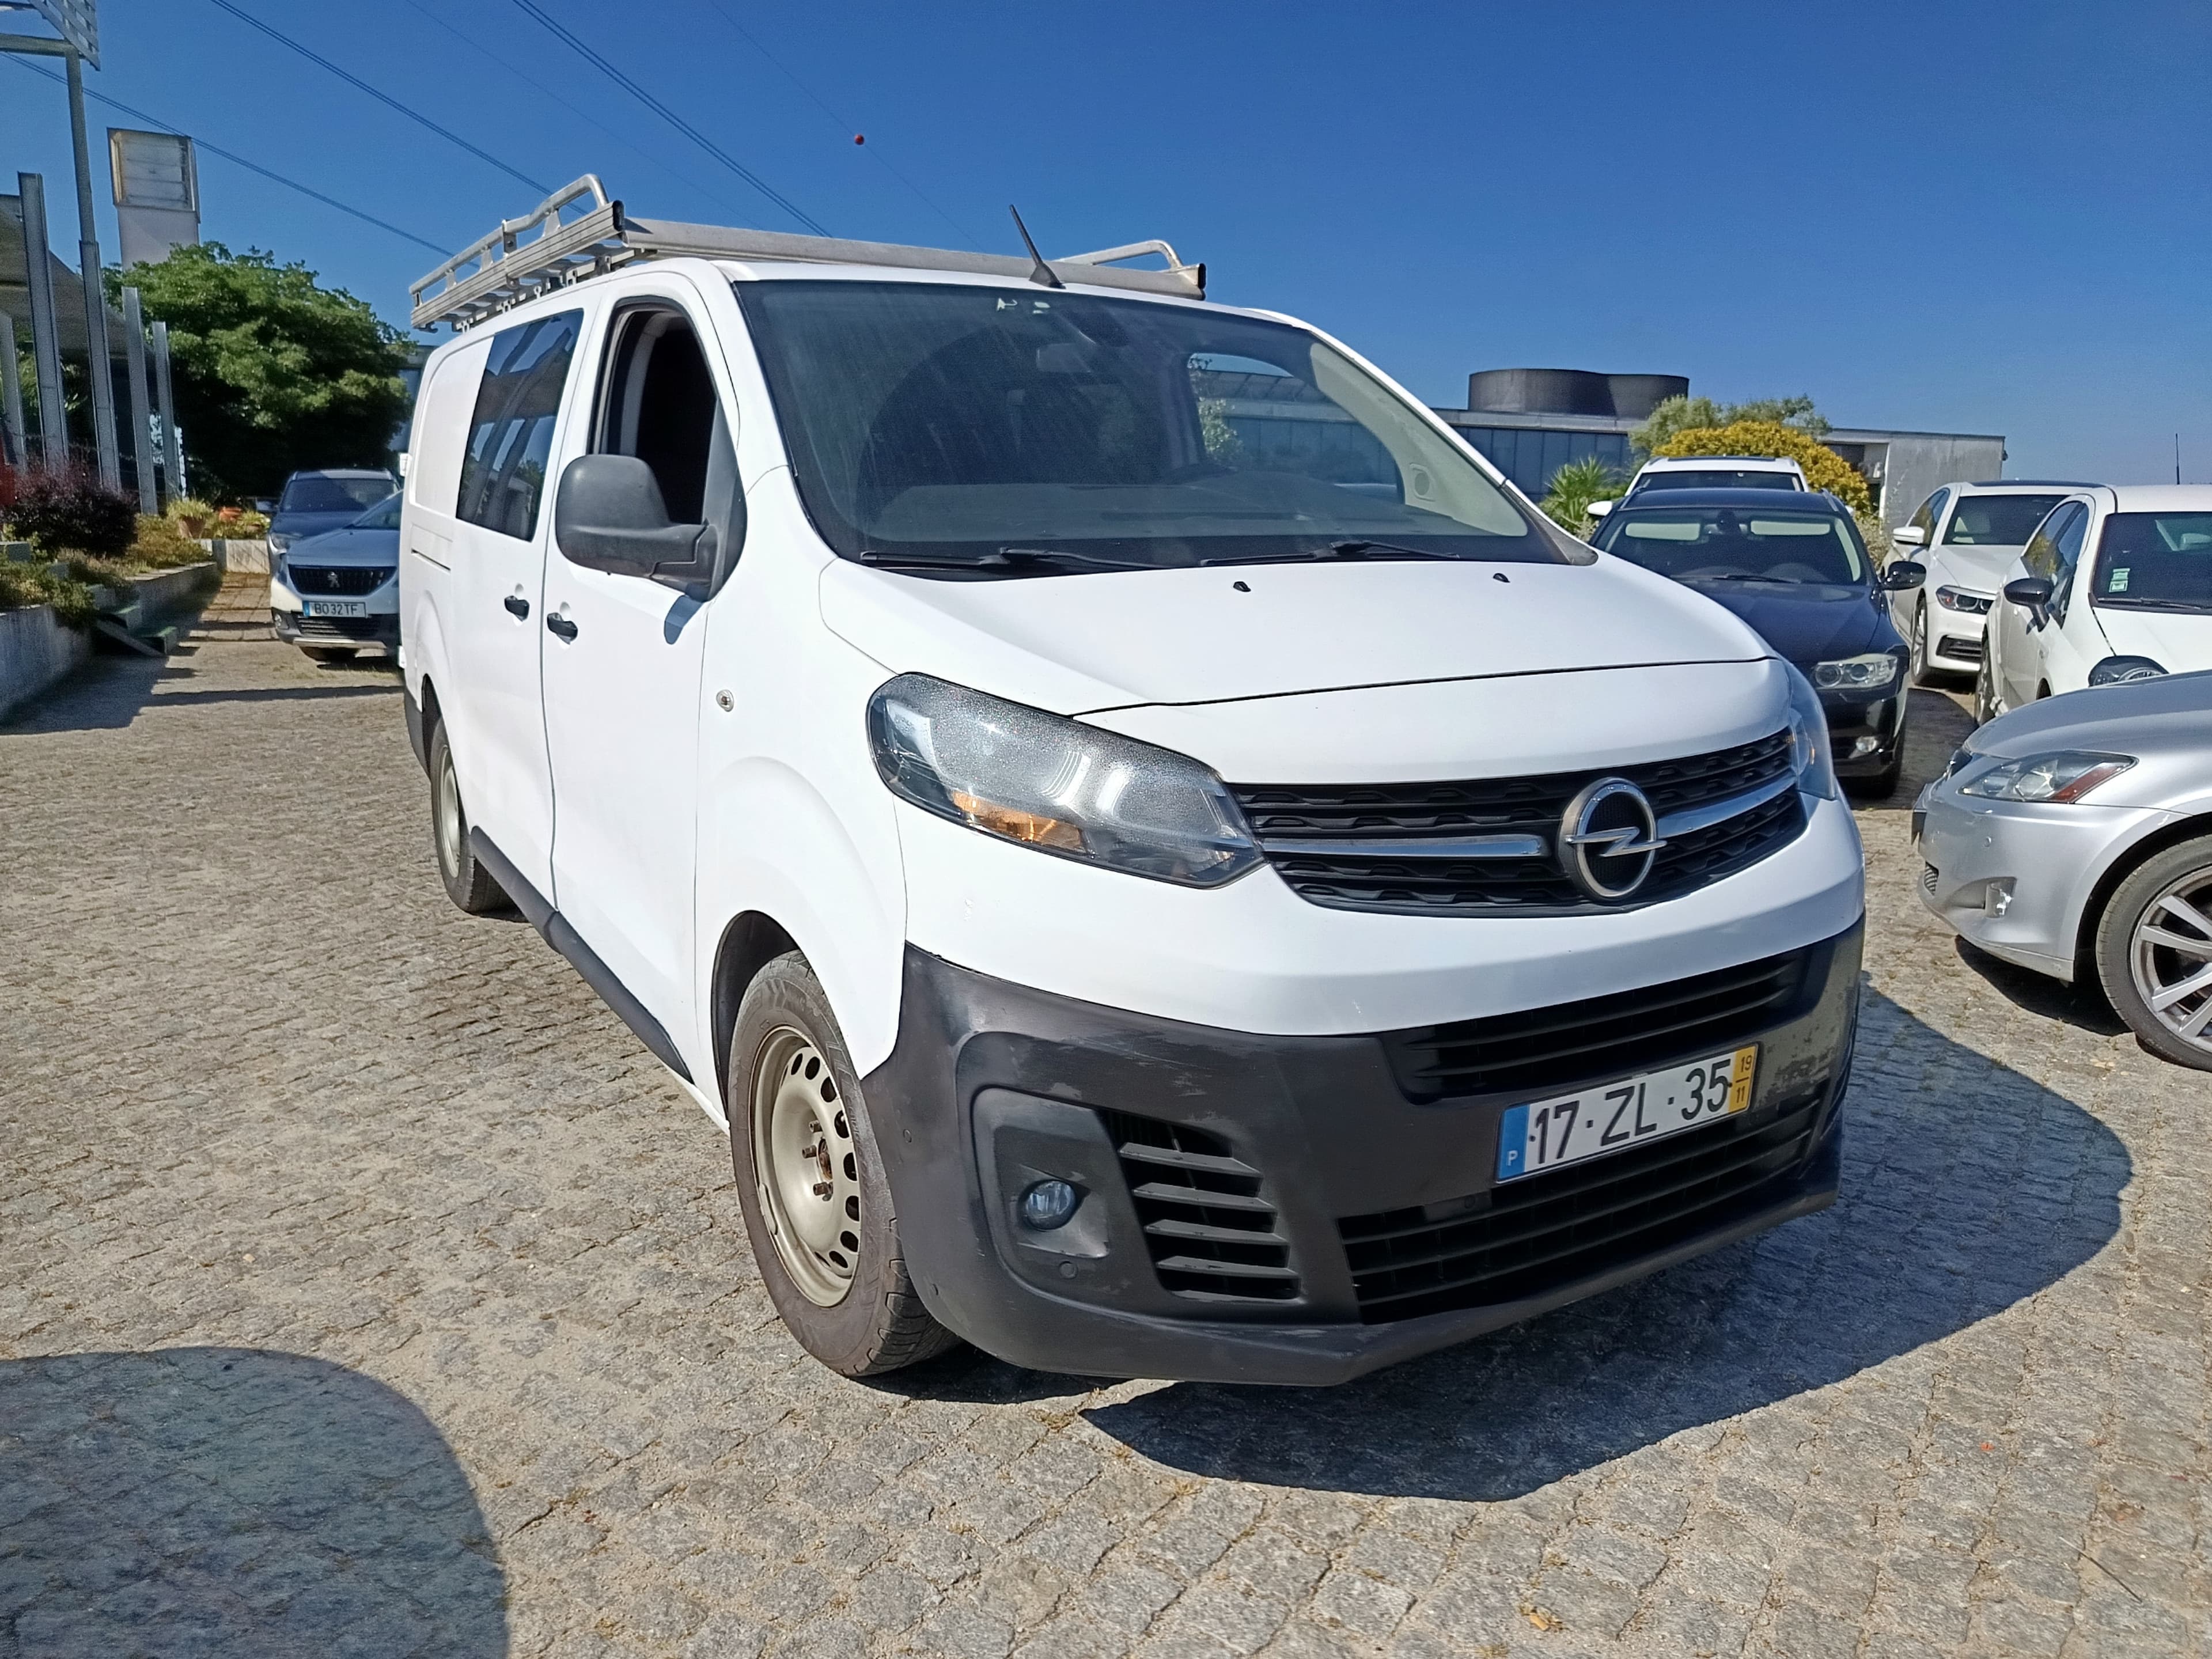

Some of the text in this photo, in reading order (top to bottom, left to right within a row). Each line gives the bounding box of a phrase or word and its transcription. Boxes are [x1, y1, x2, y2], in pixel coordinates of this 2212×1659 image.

[1741, 1055, 1752, 1073] 19
[1737, 1085, 1745, 1103] 11
[1507, 1150, 1518, 1166] P
